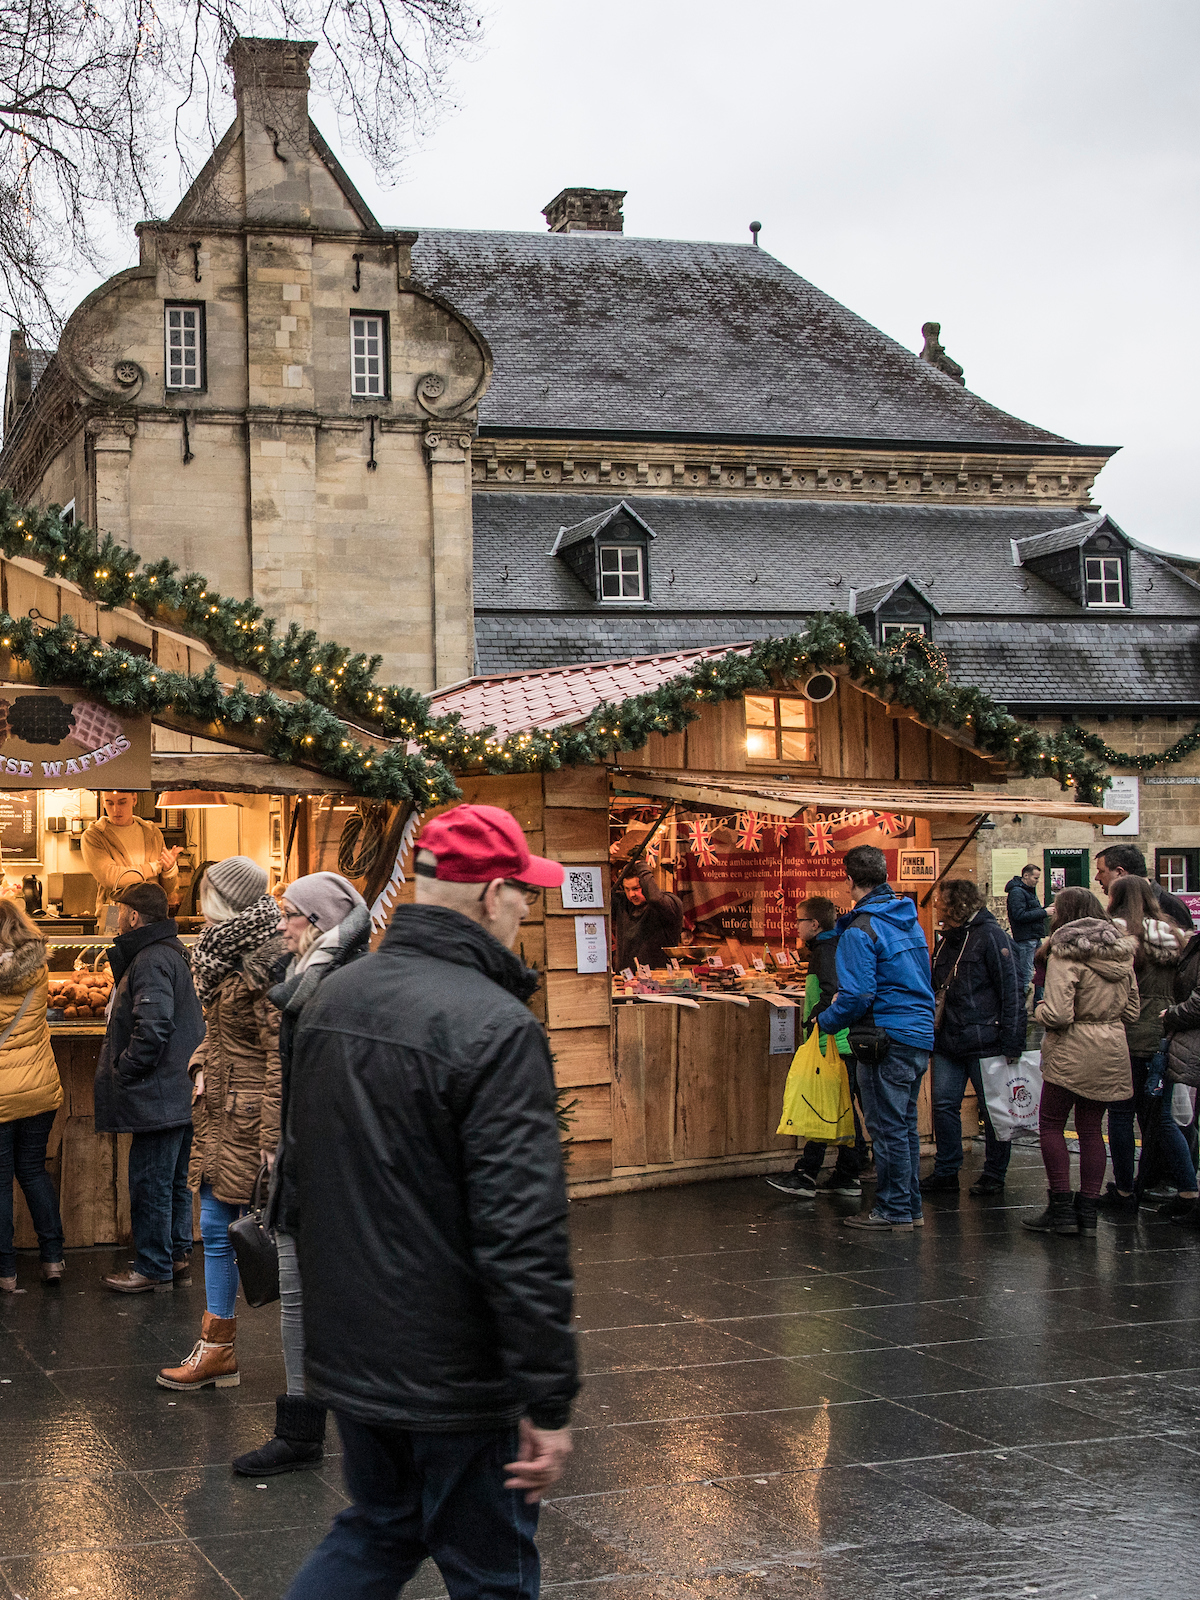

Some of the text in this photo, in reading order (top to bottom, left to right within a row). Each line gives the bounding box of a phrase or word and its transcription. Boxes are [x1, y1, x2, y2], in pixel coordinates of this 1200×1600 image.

[41, 734, 132, 778] WAFELS
[729, 857, 782, 867] ambachtelijke
[784, 856, 805, 867] fudge
[806, 855, 830, 865] wordt
[903, 857, 925, 866] PINNEN
[703, 870, 729, 879] volgens
[773, 868, 818, 878] traditioneel
[819, 868, 847, 879] Engels
[903, 866, 934, 875] JA GRAAG
[736, 887, 759, 899] Voor
[788, 887, 840, 899] informatie
